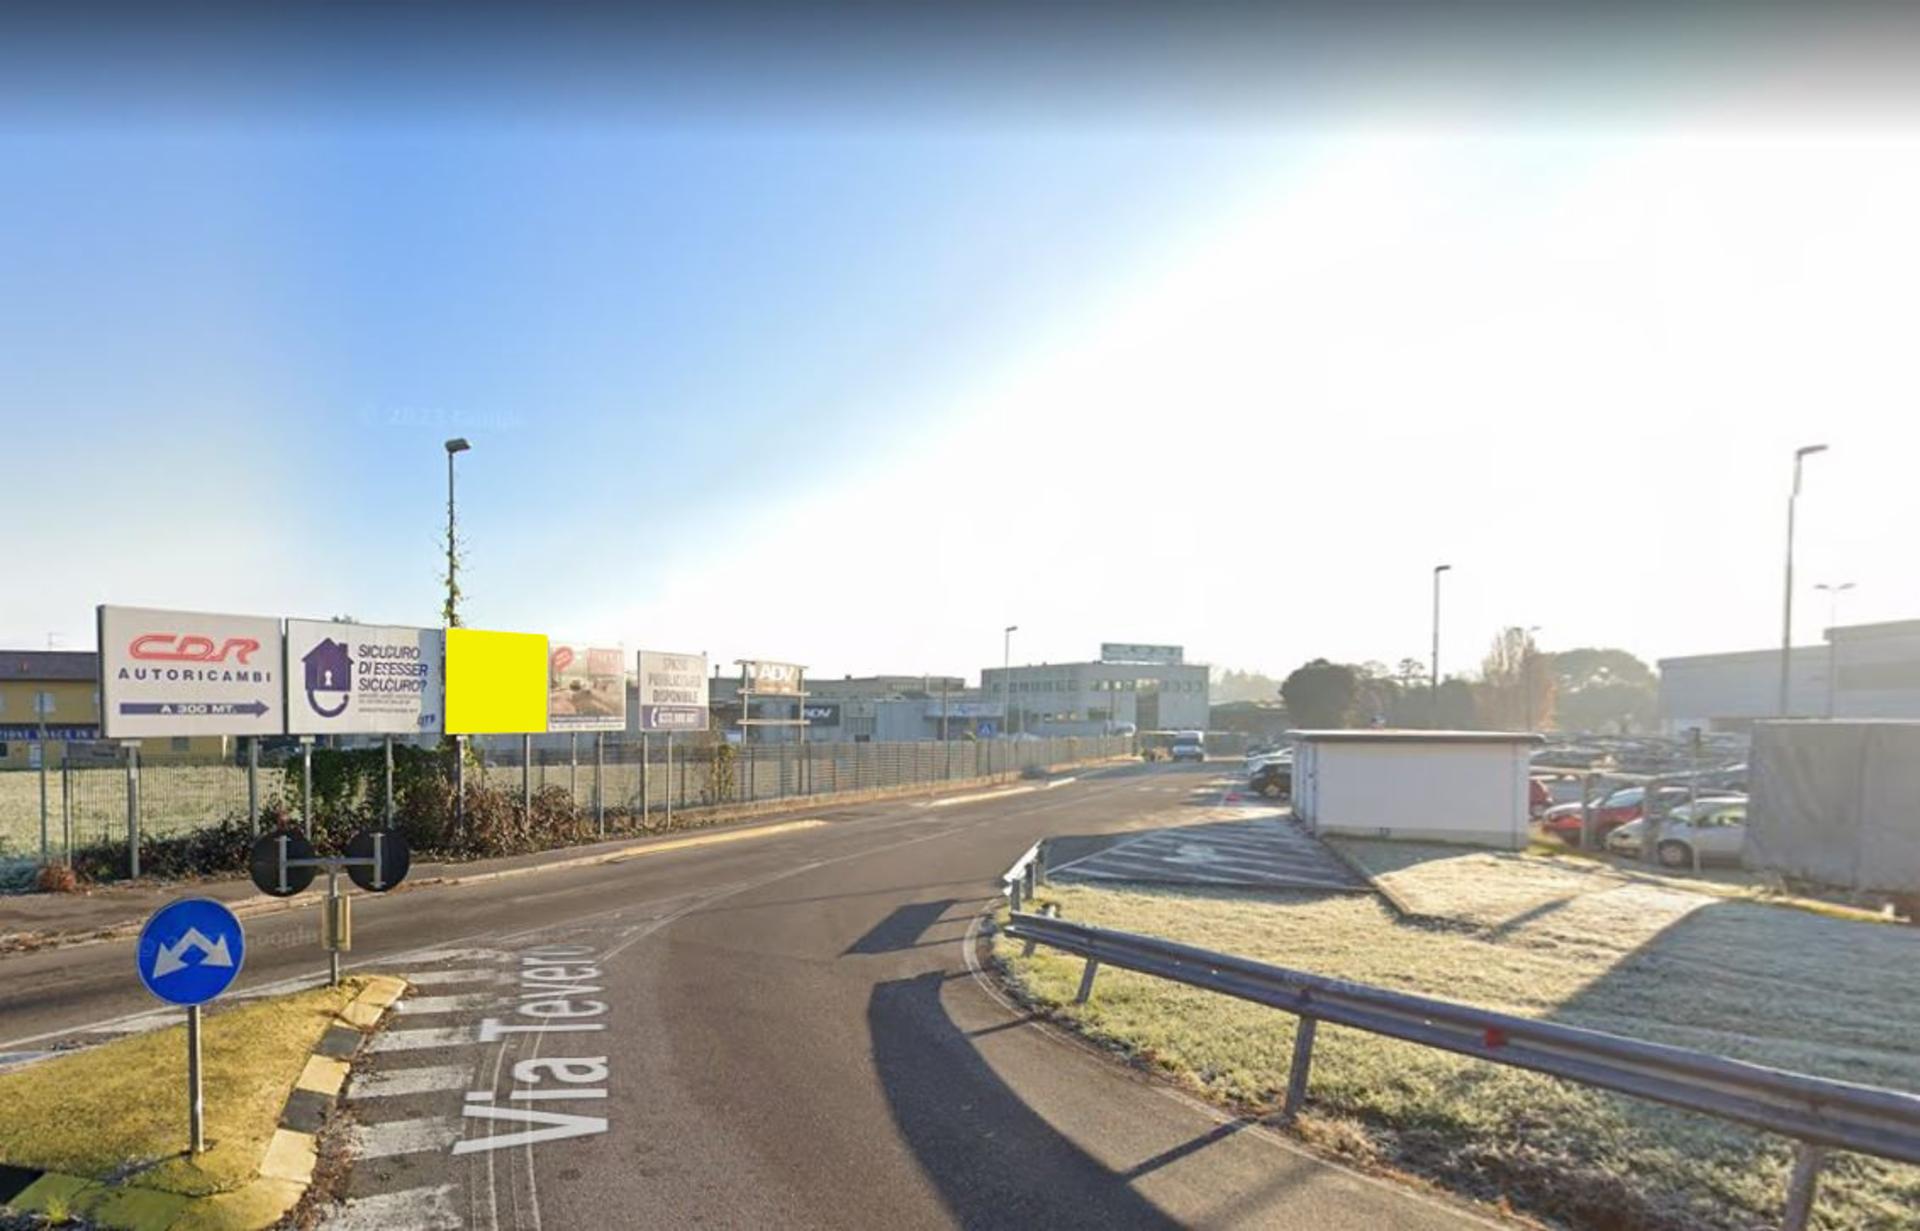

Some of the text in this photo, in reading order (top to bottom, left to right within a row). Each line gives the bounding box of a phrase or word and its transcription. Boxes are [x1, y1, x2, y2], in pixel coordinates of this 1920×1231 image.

[129, 634, 260, 665] CDR
[118, 667, 272, 683] AUTORICAMBI
[758, 663, 798, 683] ADV
[160, 703, 173, 714] A
[176, 703, 208, 715] 300
